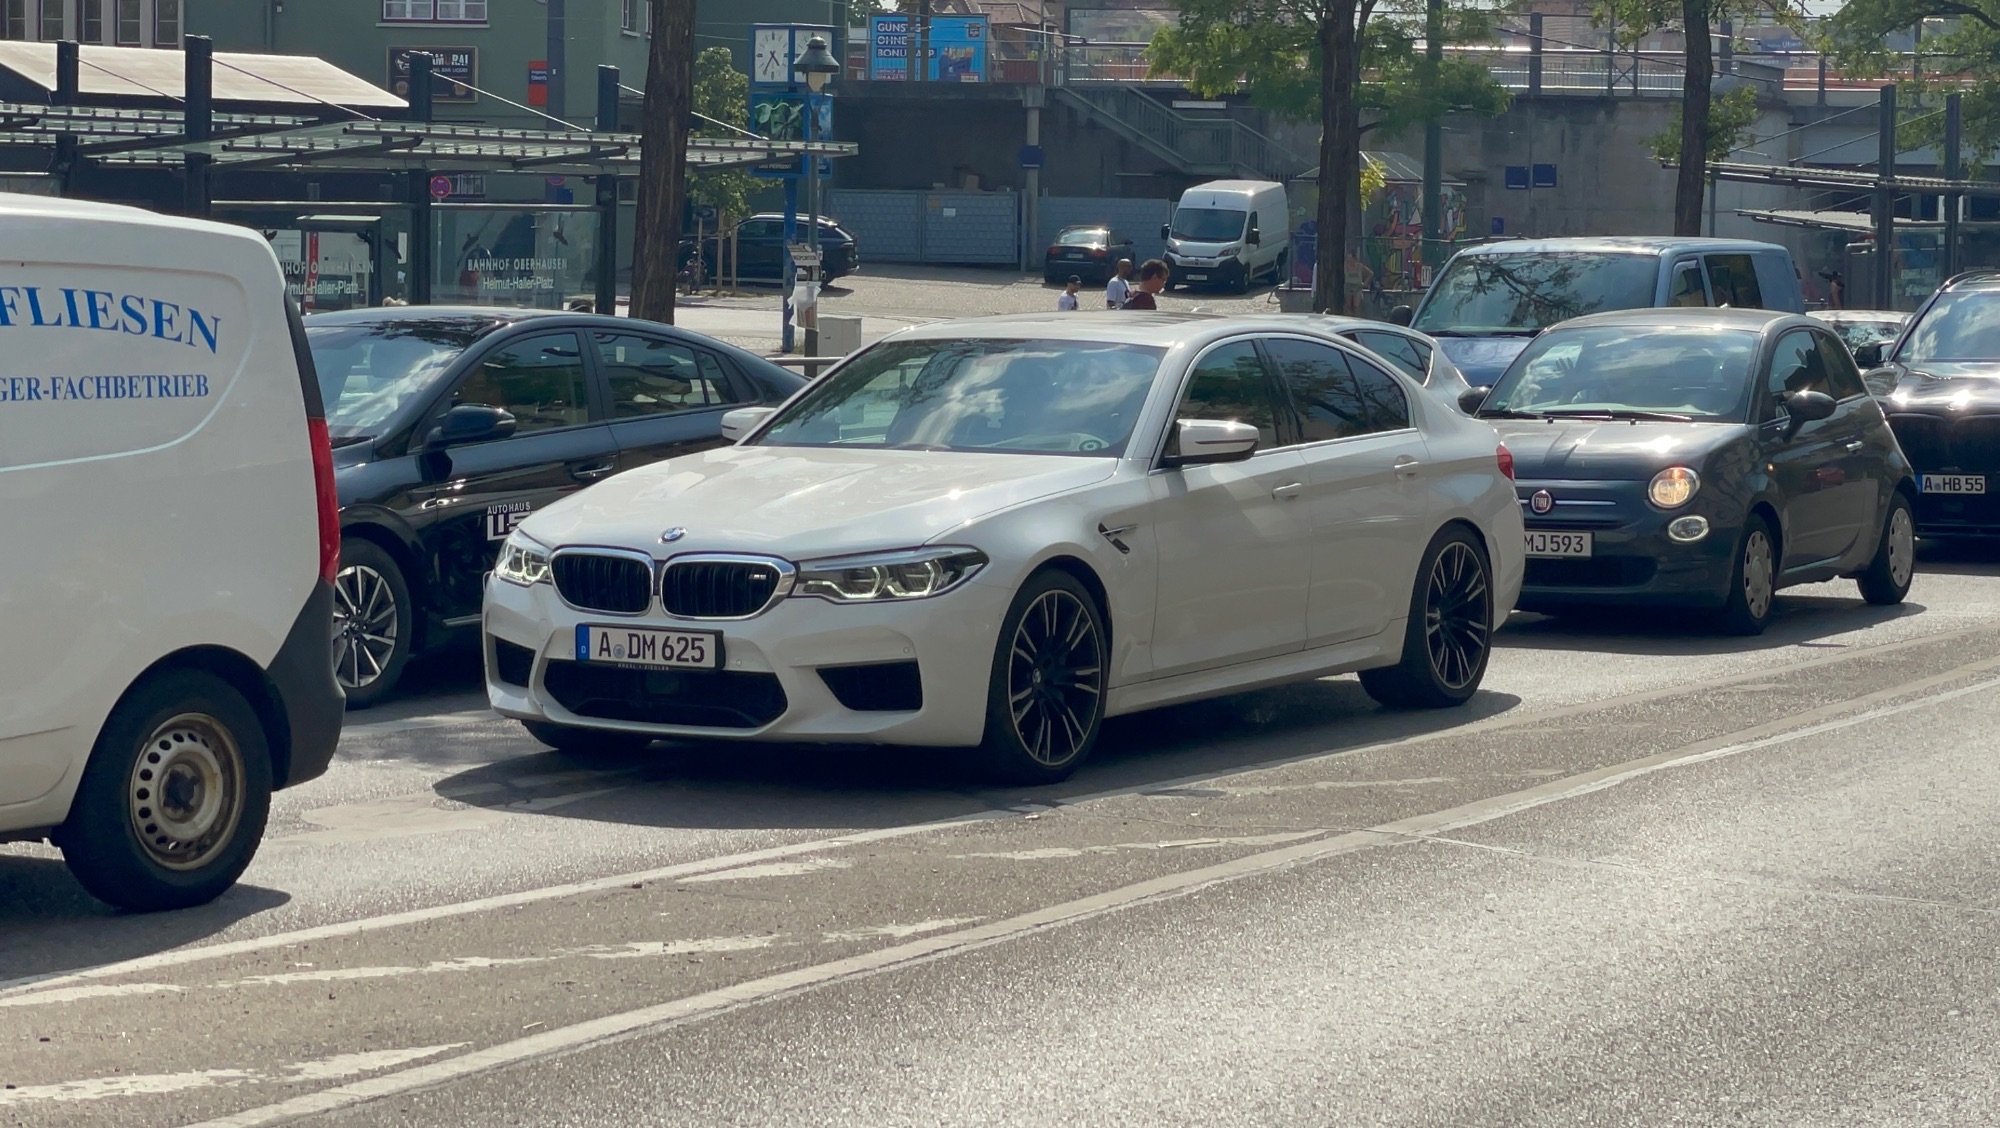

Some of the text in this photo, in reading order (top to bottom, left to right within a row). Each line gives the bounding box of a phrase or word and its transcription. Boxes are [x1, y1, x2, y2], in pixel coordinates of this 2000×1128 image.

[877, 36, 907, 45] OHNE
[467, 257, 568, 271] BAHNHOF OBERHAUSEN
[483, 276, 554, 290] Helmut-Haller-Platz
[0, 286, 222, 354] FLIESEN
[1924, 476, 1984, 492] A HB 55
[487, 502, 531, 515] AUTOHAUS
[1535, 497, 1548, 508] FIAT
[1550, 534, 1584, 553] 593
[598, 631, 705, 663] A DM 625
